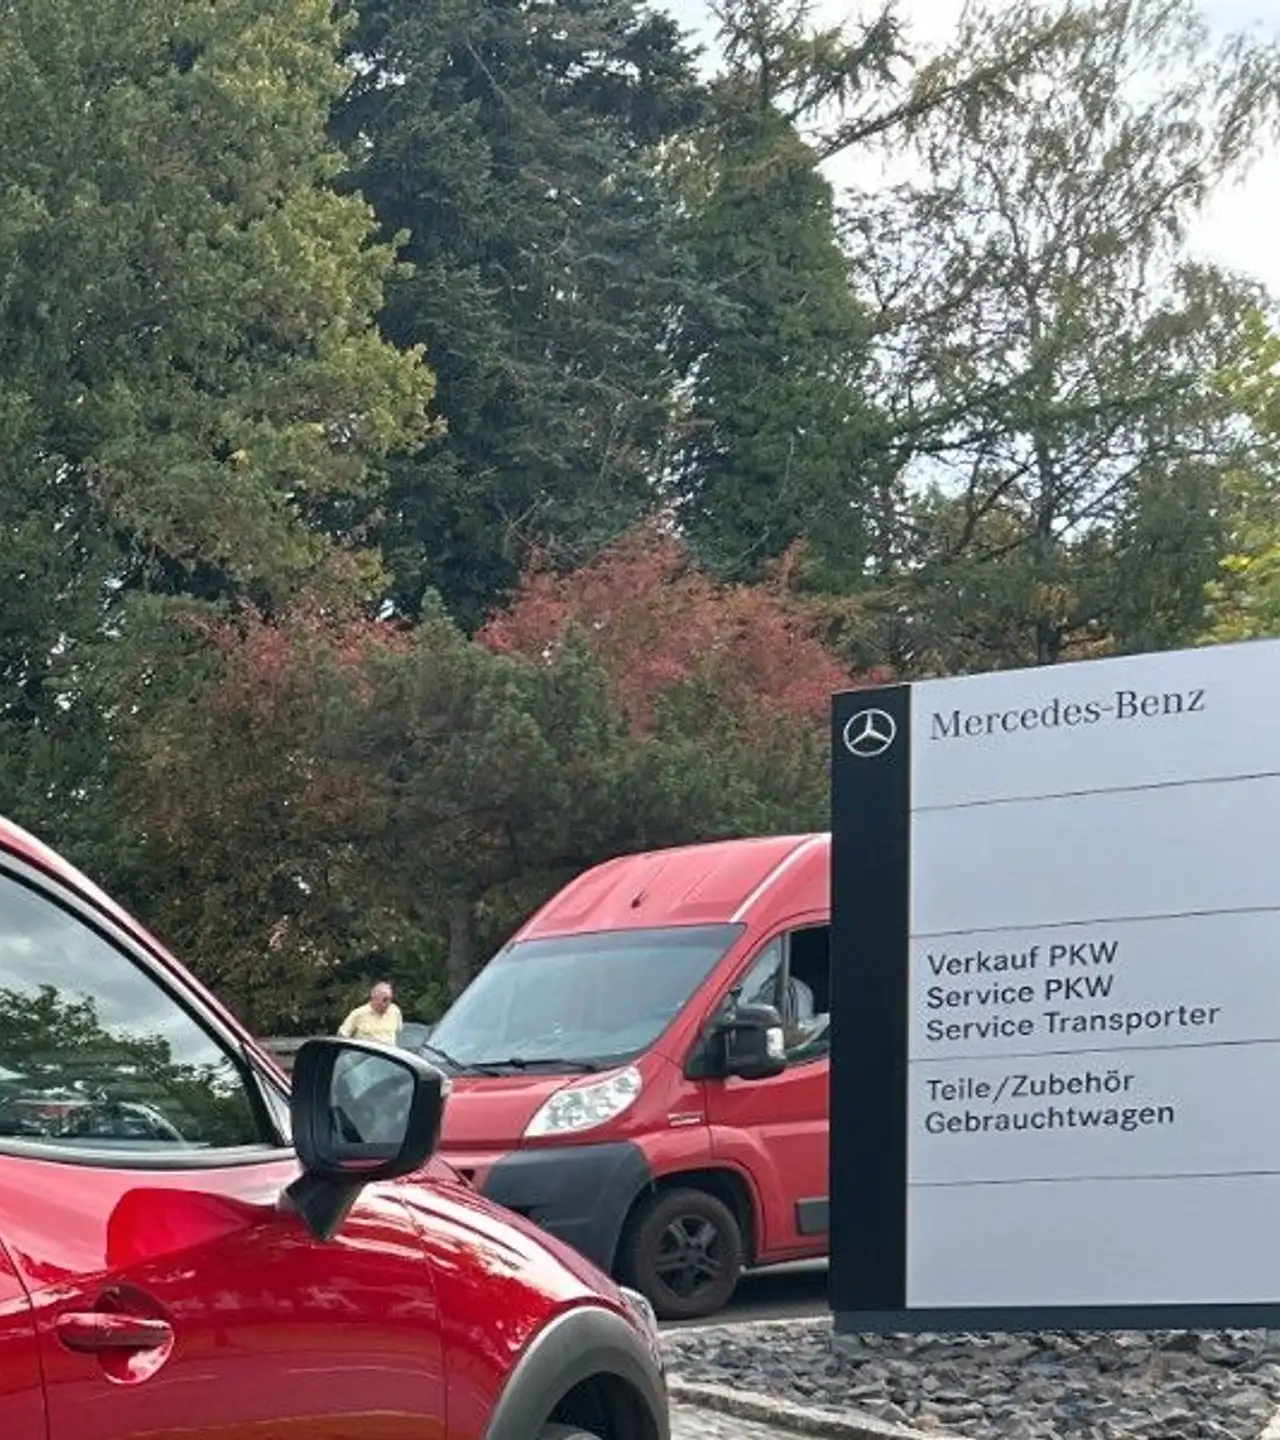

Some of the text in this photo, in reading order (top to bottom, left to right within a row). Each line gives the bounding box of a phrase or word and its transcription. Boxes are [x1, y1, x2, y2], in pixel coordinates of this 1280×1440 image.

[930, 686, 1206, 741] Mercedes-Benz
[927, 940, 1119, 976] Verkauf PKW
[927, 975, 1114, 1009] Service PKW
[926, 1005, 1221, 1041] Service Transporter
[926, 1071, 1135, 1103] Teile/Zubehör
[925, 1103, 1174, 1135] Gebrauchtwagen
